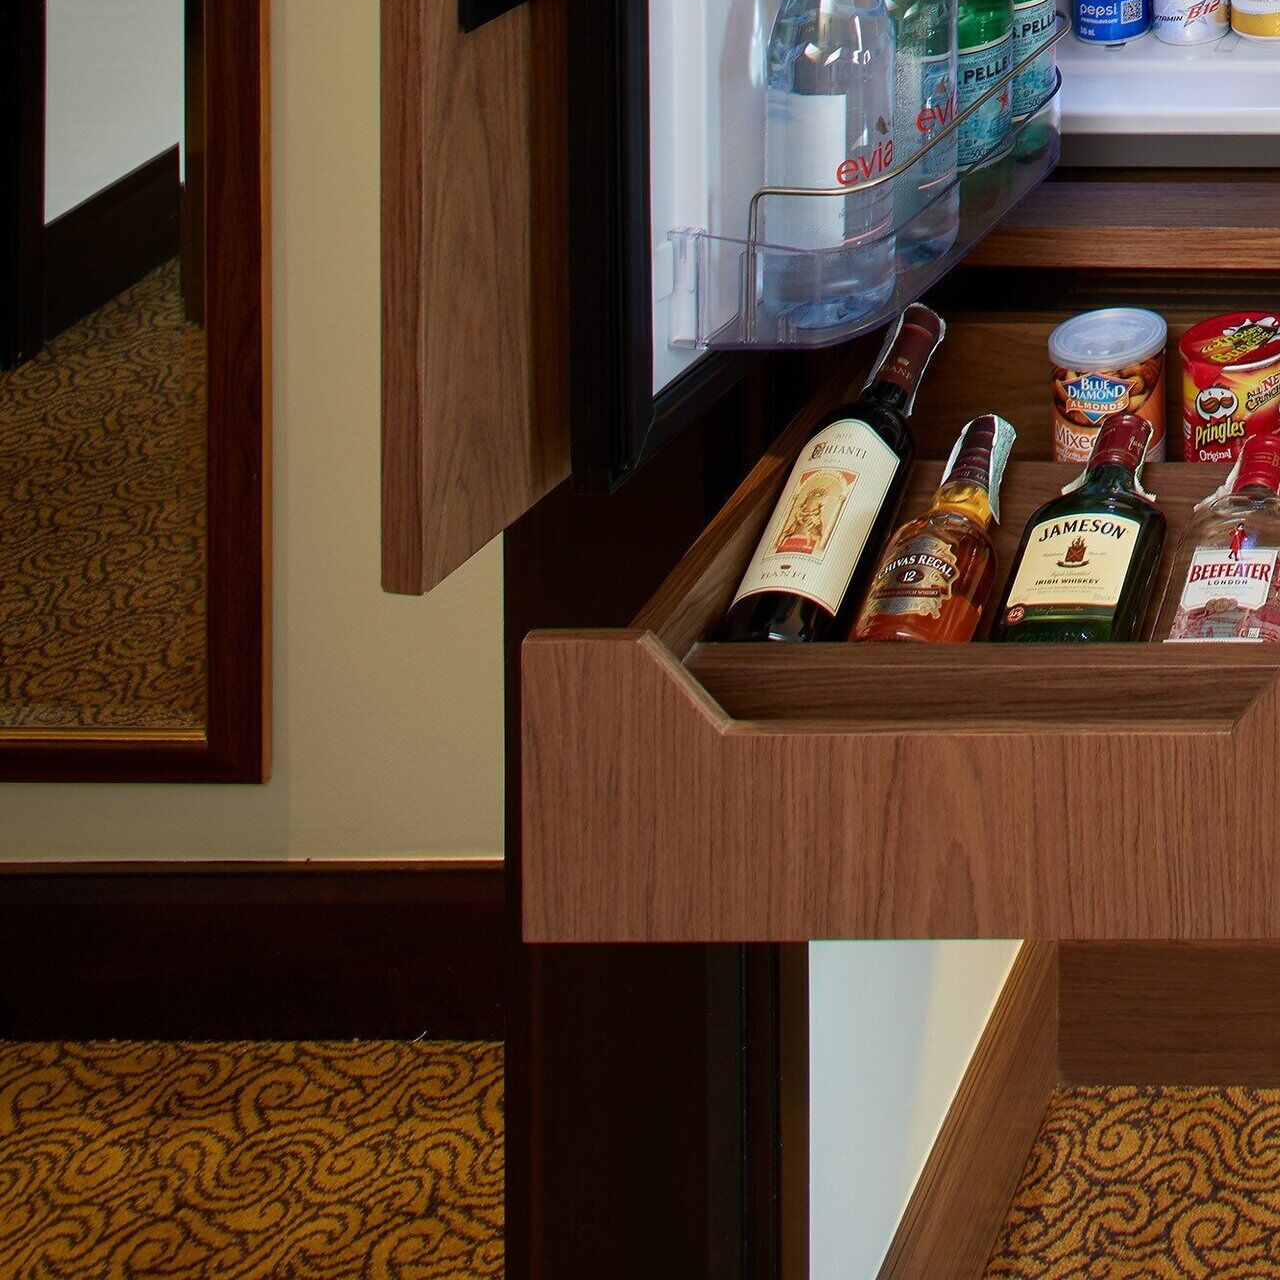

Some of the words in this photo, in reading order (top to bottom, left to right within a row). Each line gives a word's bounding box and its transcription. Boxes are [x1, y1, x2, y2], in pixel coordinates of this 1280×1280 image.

[1079, 2, 1118, 19] pepsi
[1080, 378, 1110, 391] BLUE
[1068, 384, 1126, 402] DIAMOND
[1247, 386, 1263, 400] ALL
[1070, 400, 1125, 411] ALMONDS
[1194, 416, 1247, 451] Pringles
[808, 440, 867, 462] CHIANTI
[1199, 448, 1233, 463] Original
[1038, 519, 1126, 543] JAMESON
[877, 554, 916, 580] CHIVAS
[917, 554, 953, 578] REGAL
[1188, 562, 1272, 584] BEEFEATER
[760, 570, 808, 581] BANFI
[902, 569, 917, 583] 12
[1035, 578, 1059, 586] IRISH
[1060, 577, 1100, 585] WHISKEY
[1207, 578, 1249, 586] LONDON
